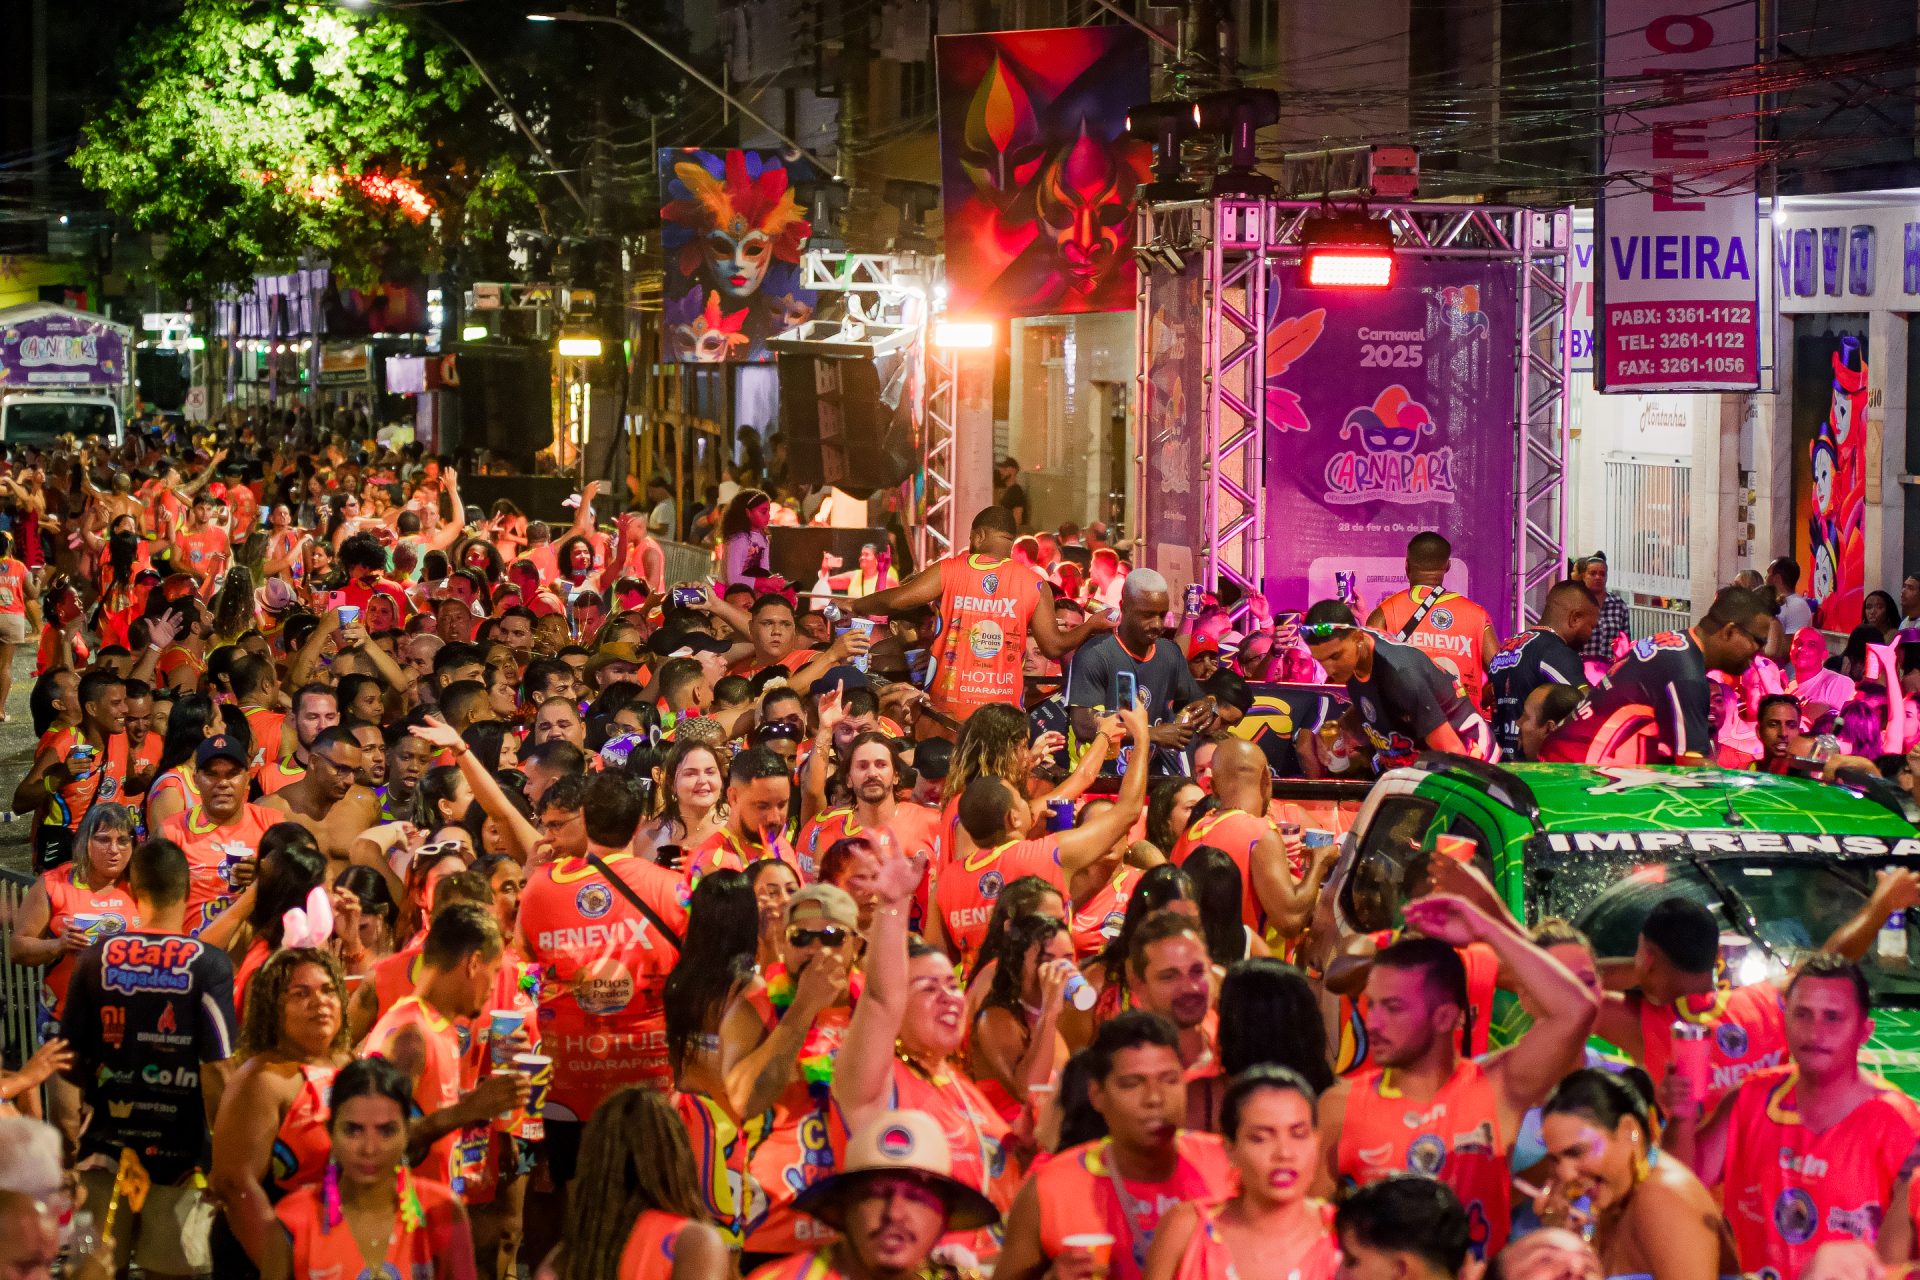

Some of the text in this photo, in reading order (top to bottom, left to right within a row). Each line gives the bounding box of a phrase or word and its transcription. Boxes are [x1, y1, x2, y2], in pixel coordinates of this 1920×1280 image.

[1610, 235, 1750, 281] VIEIRA
[1611, 307, 1751, 326] PABX: 3361-1122
[1357, 326, 1426, 342] Carnaval
[1617, 332, 1745, 351] TEL: 3261-1122
[1360, 344, 1423, 368] 2025
[1617, 357, 1745, 376] FAX: 3261-1056
[1326, 449, 1454, 492] CARNAPARI
[1338, 523, 1350, 532] 28
[1352, 523, 1364, 532] de
[1407, 523, 1419, 532] de
[961, 670, 1014, 685] HOTUR
[959, 685, 1014, 696] GUARAPARI
[538, 917, 654, 951] BENEVIX
[107, 938, 199, 969] Staff
